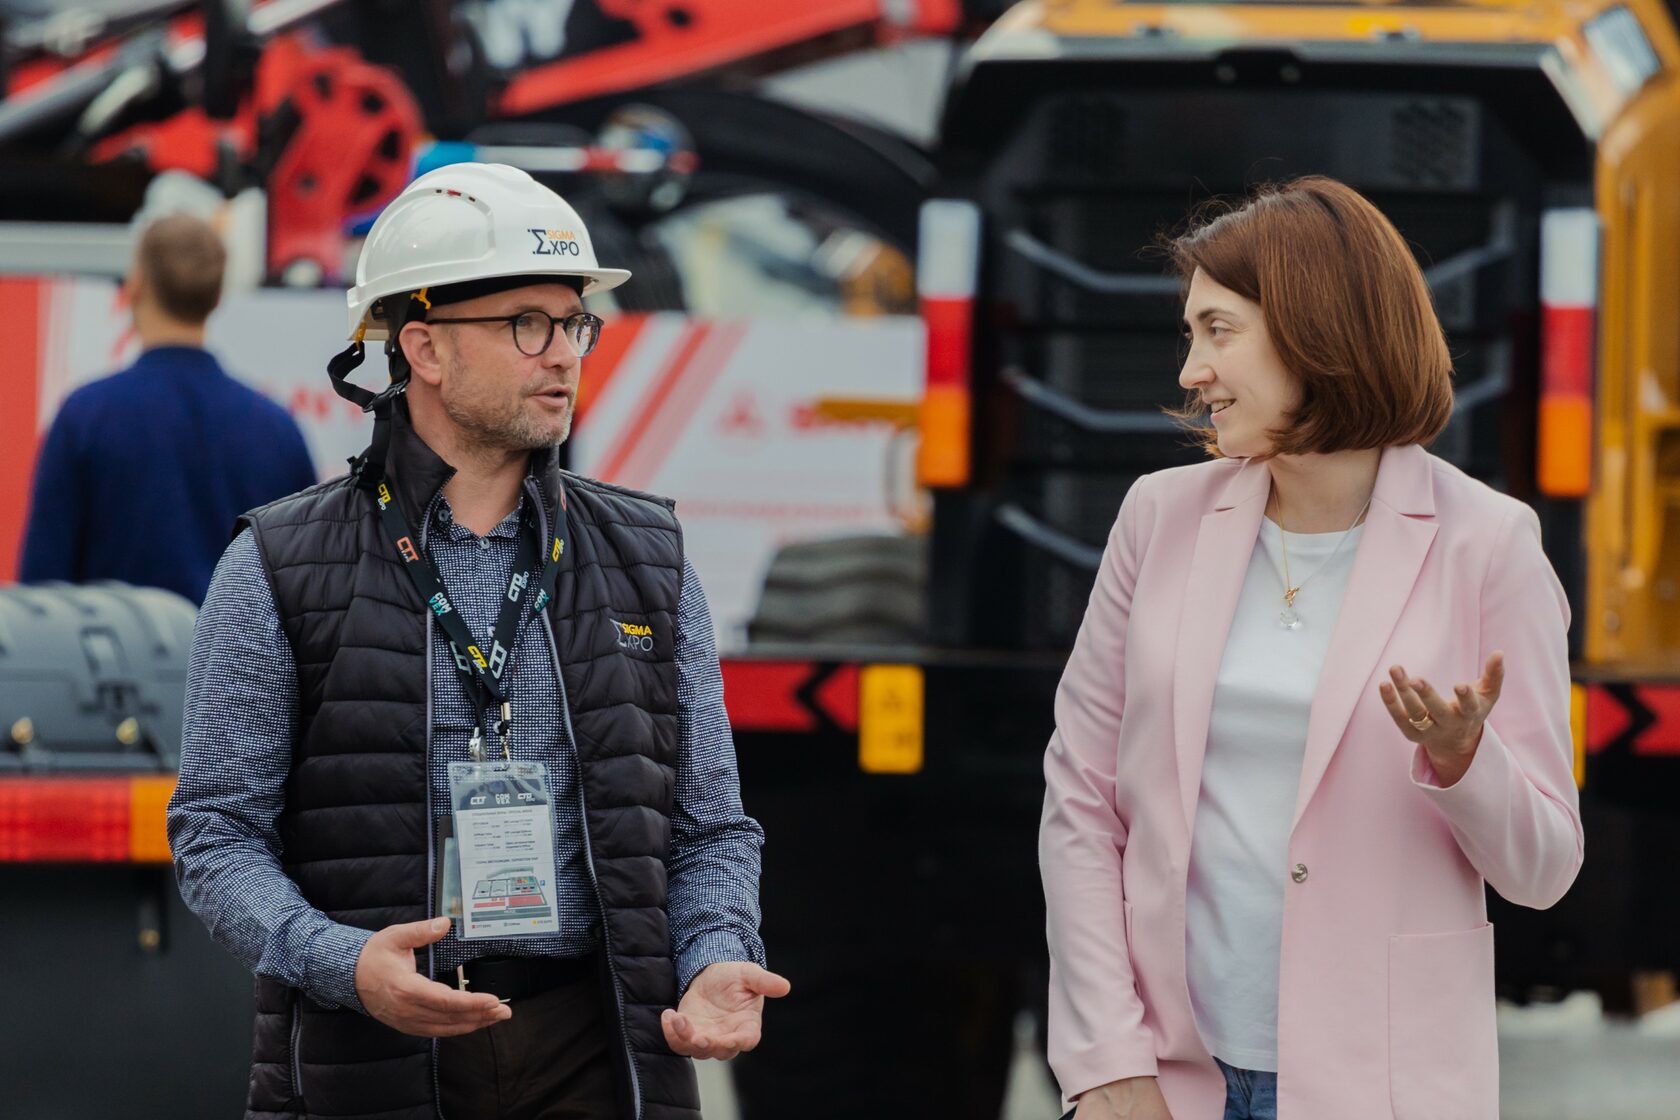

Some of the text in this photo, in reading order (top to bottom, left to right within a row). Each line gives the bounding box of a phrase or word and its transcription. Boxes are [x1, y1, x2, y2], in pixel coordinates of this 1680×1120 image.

[547, 229, 577, 241] SIGMA
[429, 596, 443, 616] VEX
[434, 592, 452, 614] COM
[621, 623, 653, 636] SIGMA
